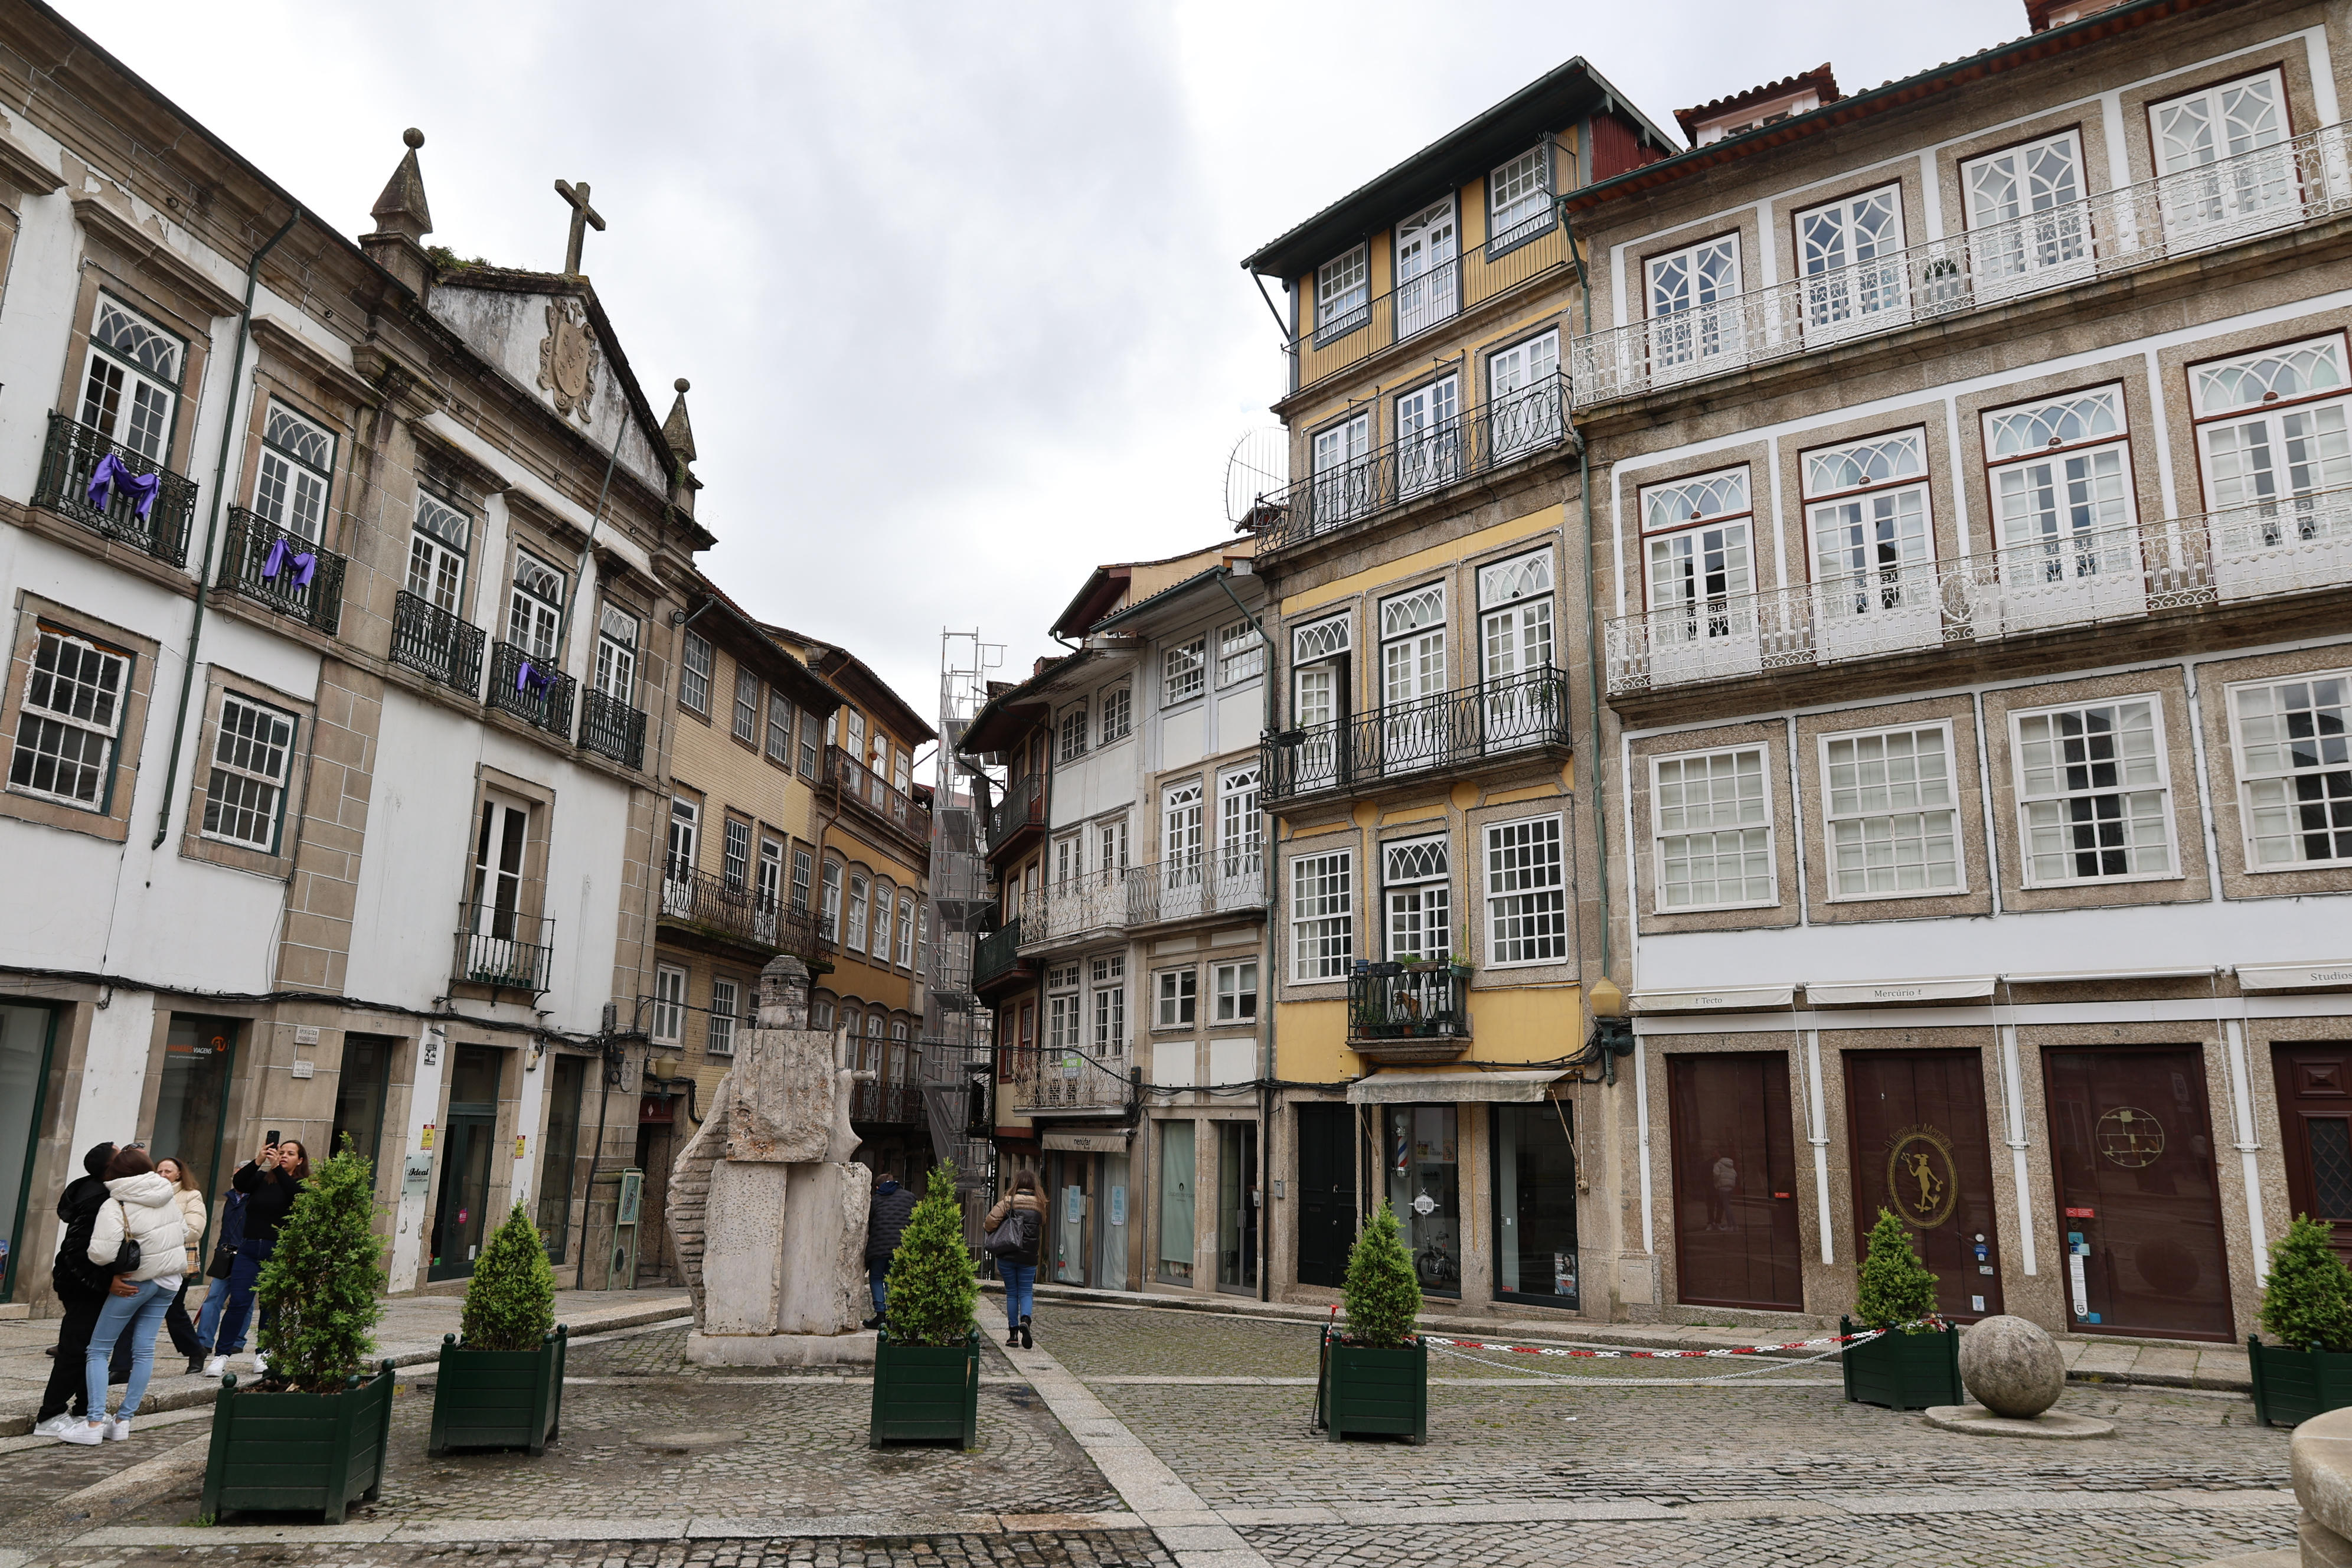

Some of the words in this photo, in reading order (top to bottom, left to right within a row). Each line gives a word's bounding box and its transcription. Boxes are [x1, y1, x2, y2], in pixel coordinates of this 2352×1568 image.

[2310, 971, 2352, 981] Studios
[1874, 989, 1915, 997] Mercúrio
[409, 1168, 429, 1176] Ideal
